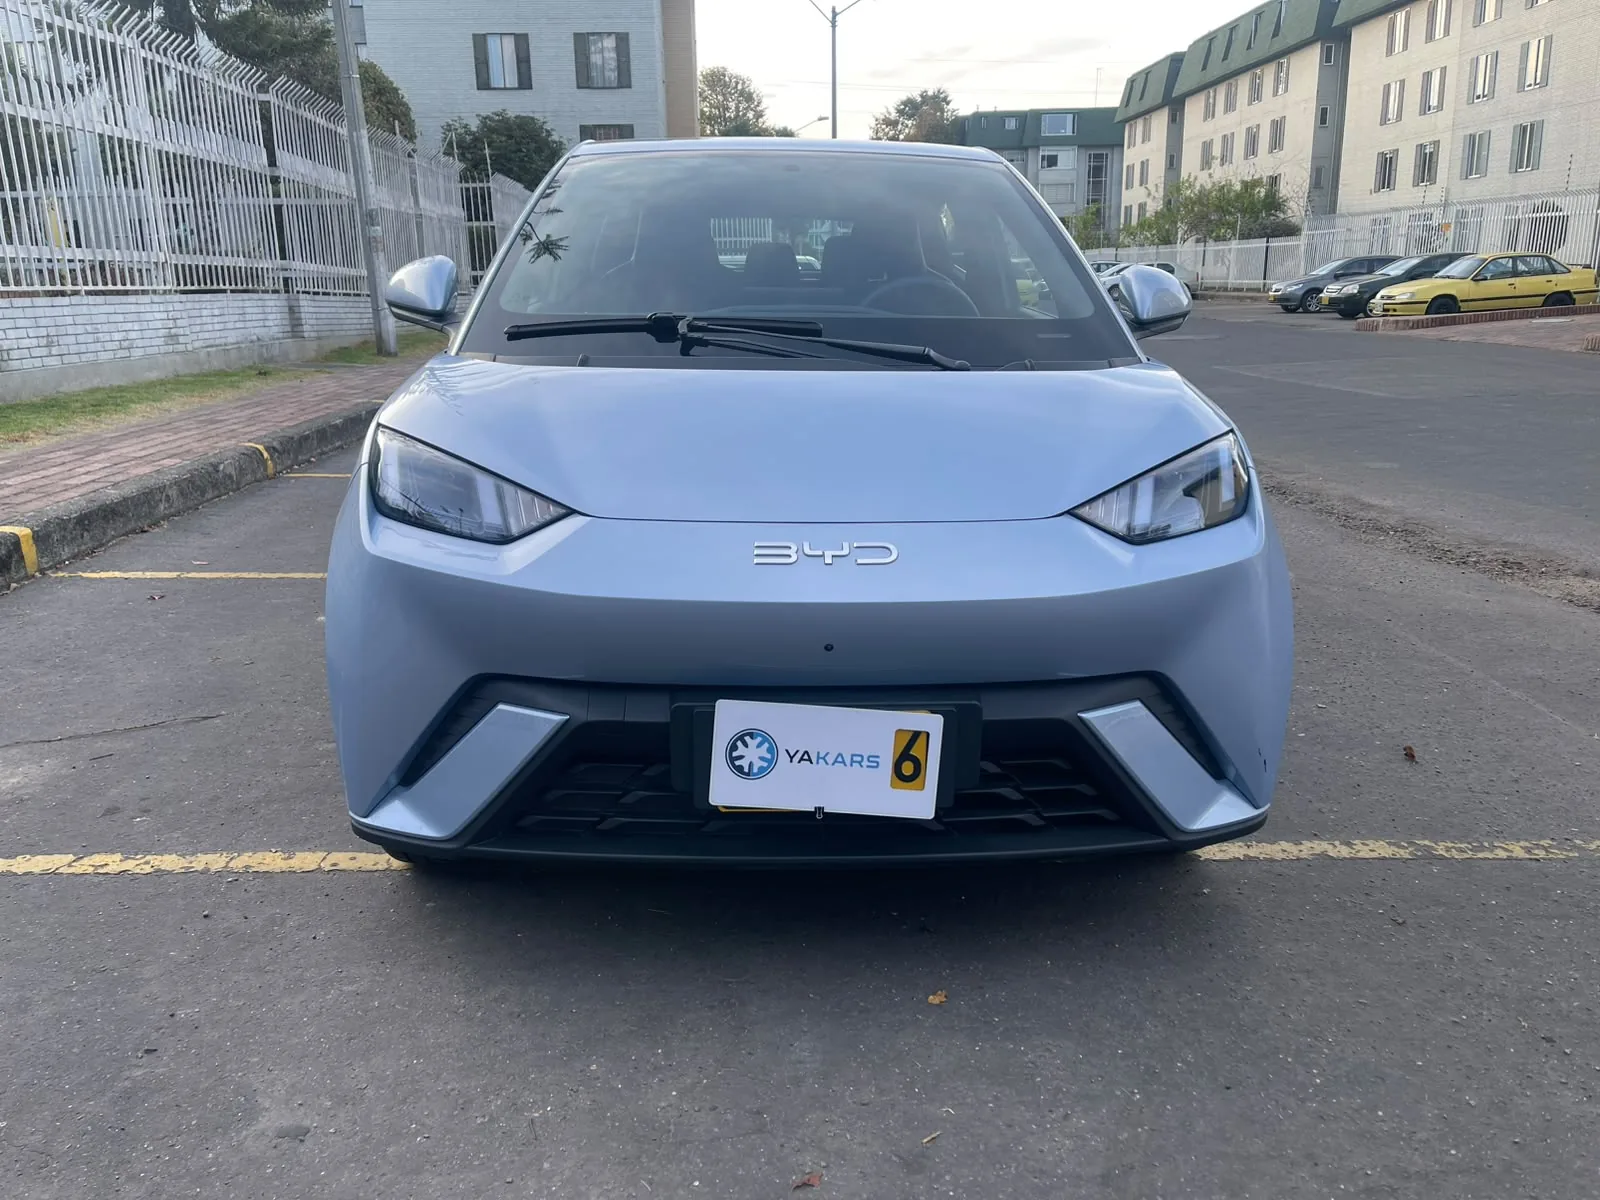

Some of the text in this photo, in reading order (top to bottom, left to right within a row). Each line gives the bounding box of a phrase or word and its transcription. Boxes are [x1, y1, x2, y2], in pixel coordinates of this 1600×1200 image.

[753, 541, 898, 565] BYD
[784, 748, 880, 769] YAKARS
[894, 731, 922, 783] 6
